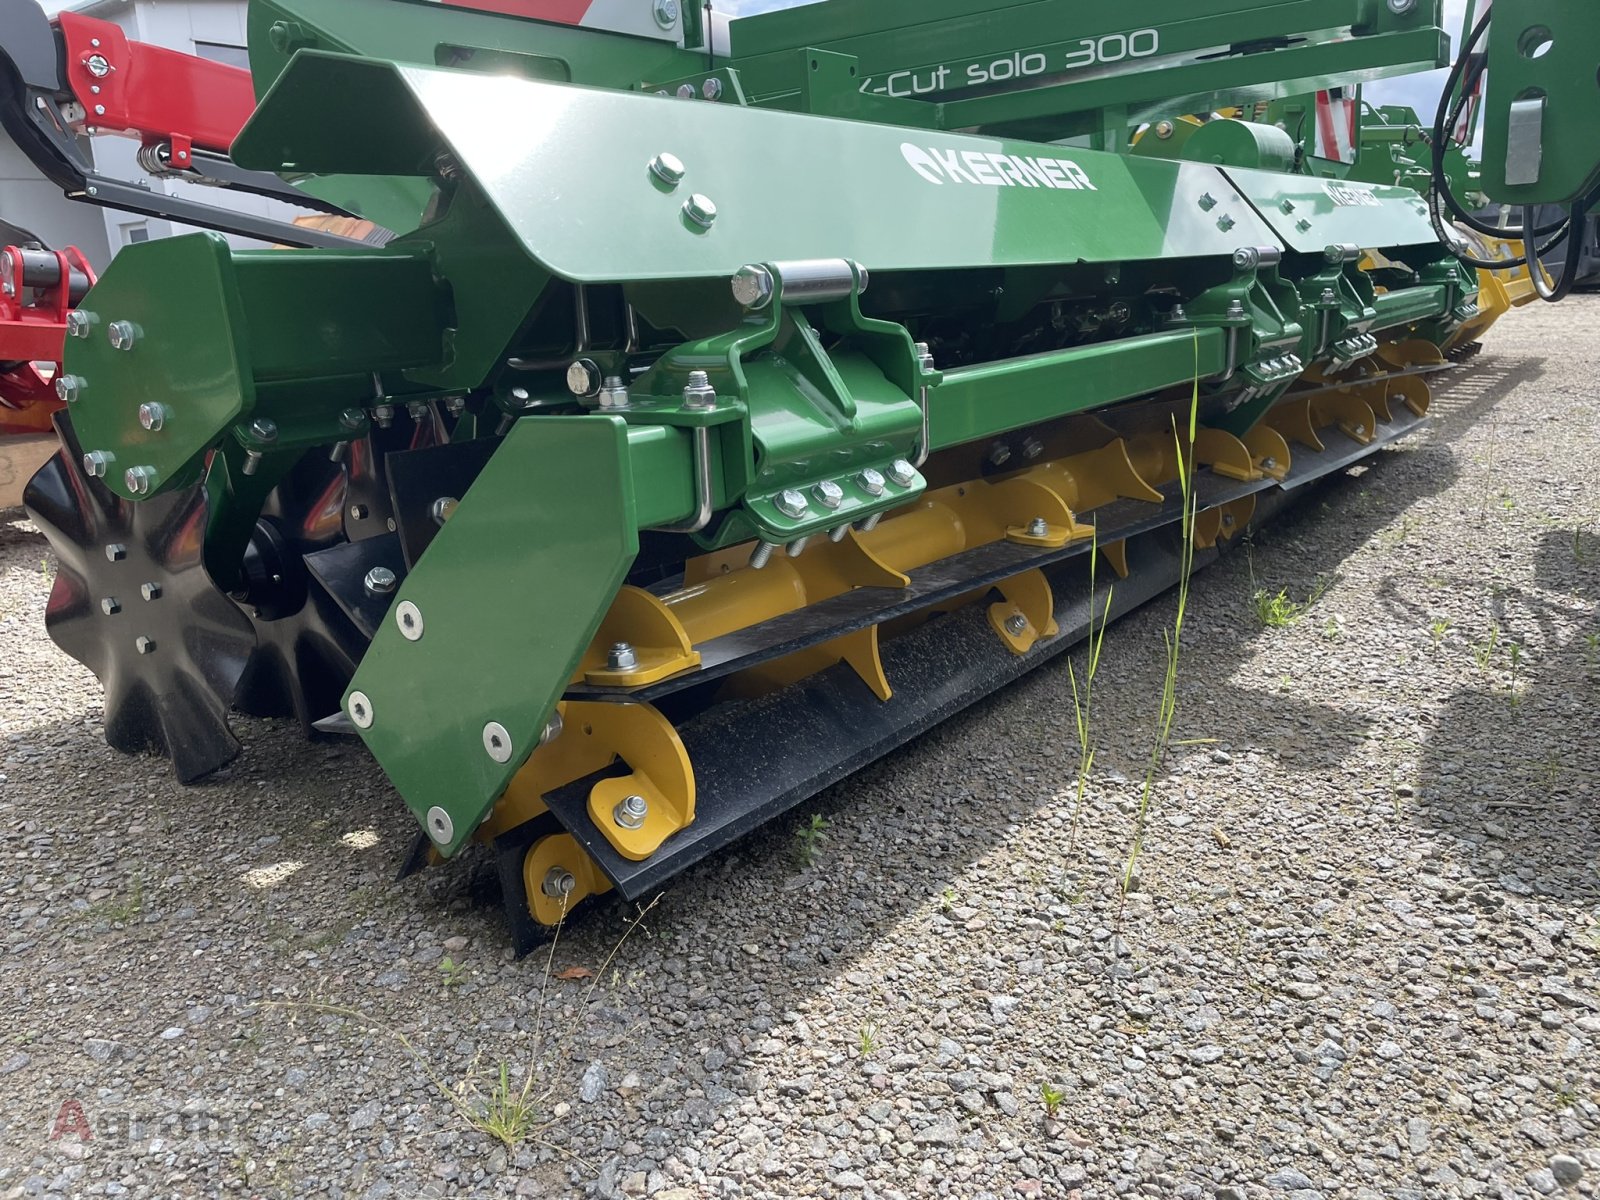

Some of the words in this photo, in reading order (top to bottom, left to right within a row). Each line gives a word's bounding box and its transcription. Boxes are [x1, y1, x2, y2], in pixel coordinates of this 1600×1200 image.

[967, 52, 1046, 85] solo
[1066, 28, 1159, 68] 300
[928, 148, 1098, 190] KERNER
[1325, 185, 1383, 206] KERNER
